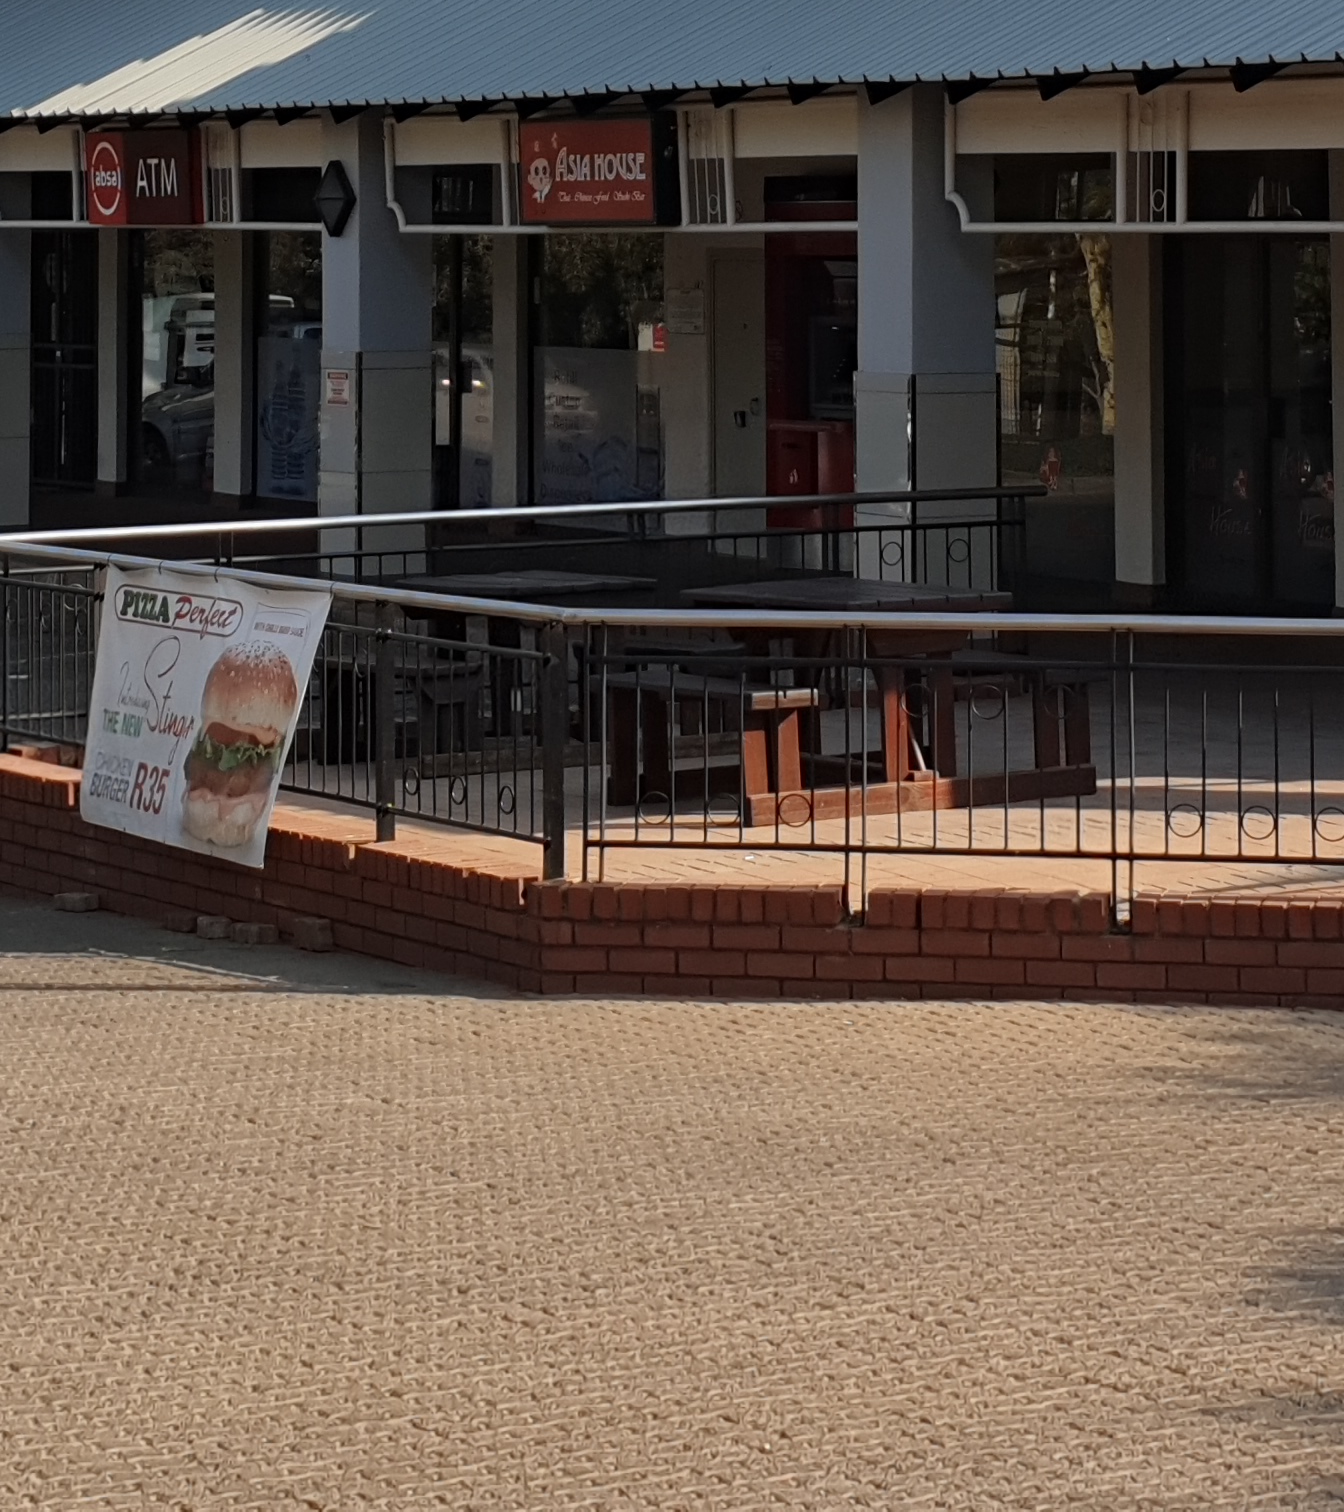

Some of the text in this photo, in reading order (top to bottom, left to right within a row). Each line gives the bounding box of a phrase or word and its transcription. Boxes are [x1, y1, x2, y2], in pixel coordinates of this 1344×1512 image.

[95, 164, 118, 187] absa
[136, 157, 179, 198] ATM
[555, 146, 647, 182] ASIA HOUSE
[120, 589, 238, 641] PIZZA Perfect
[102, 707, 144, 739] THE NEW
[89, 772, 130, 804] BURGER
[129, 762, 170, 815] R35
